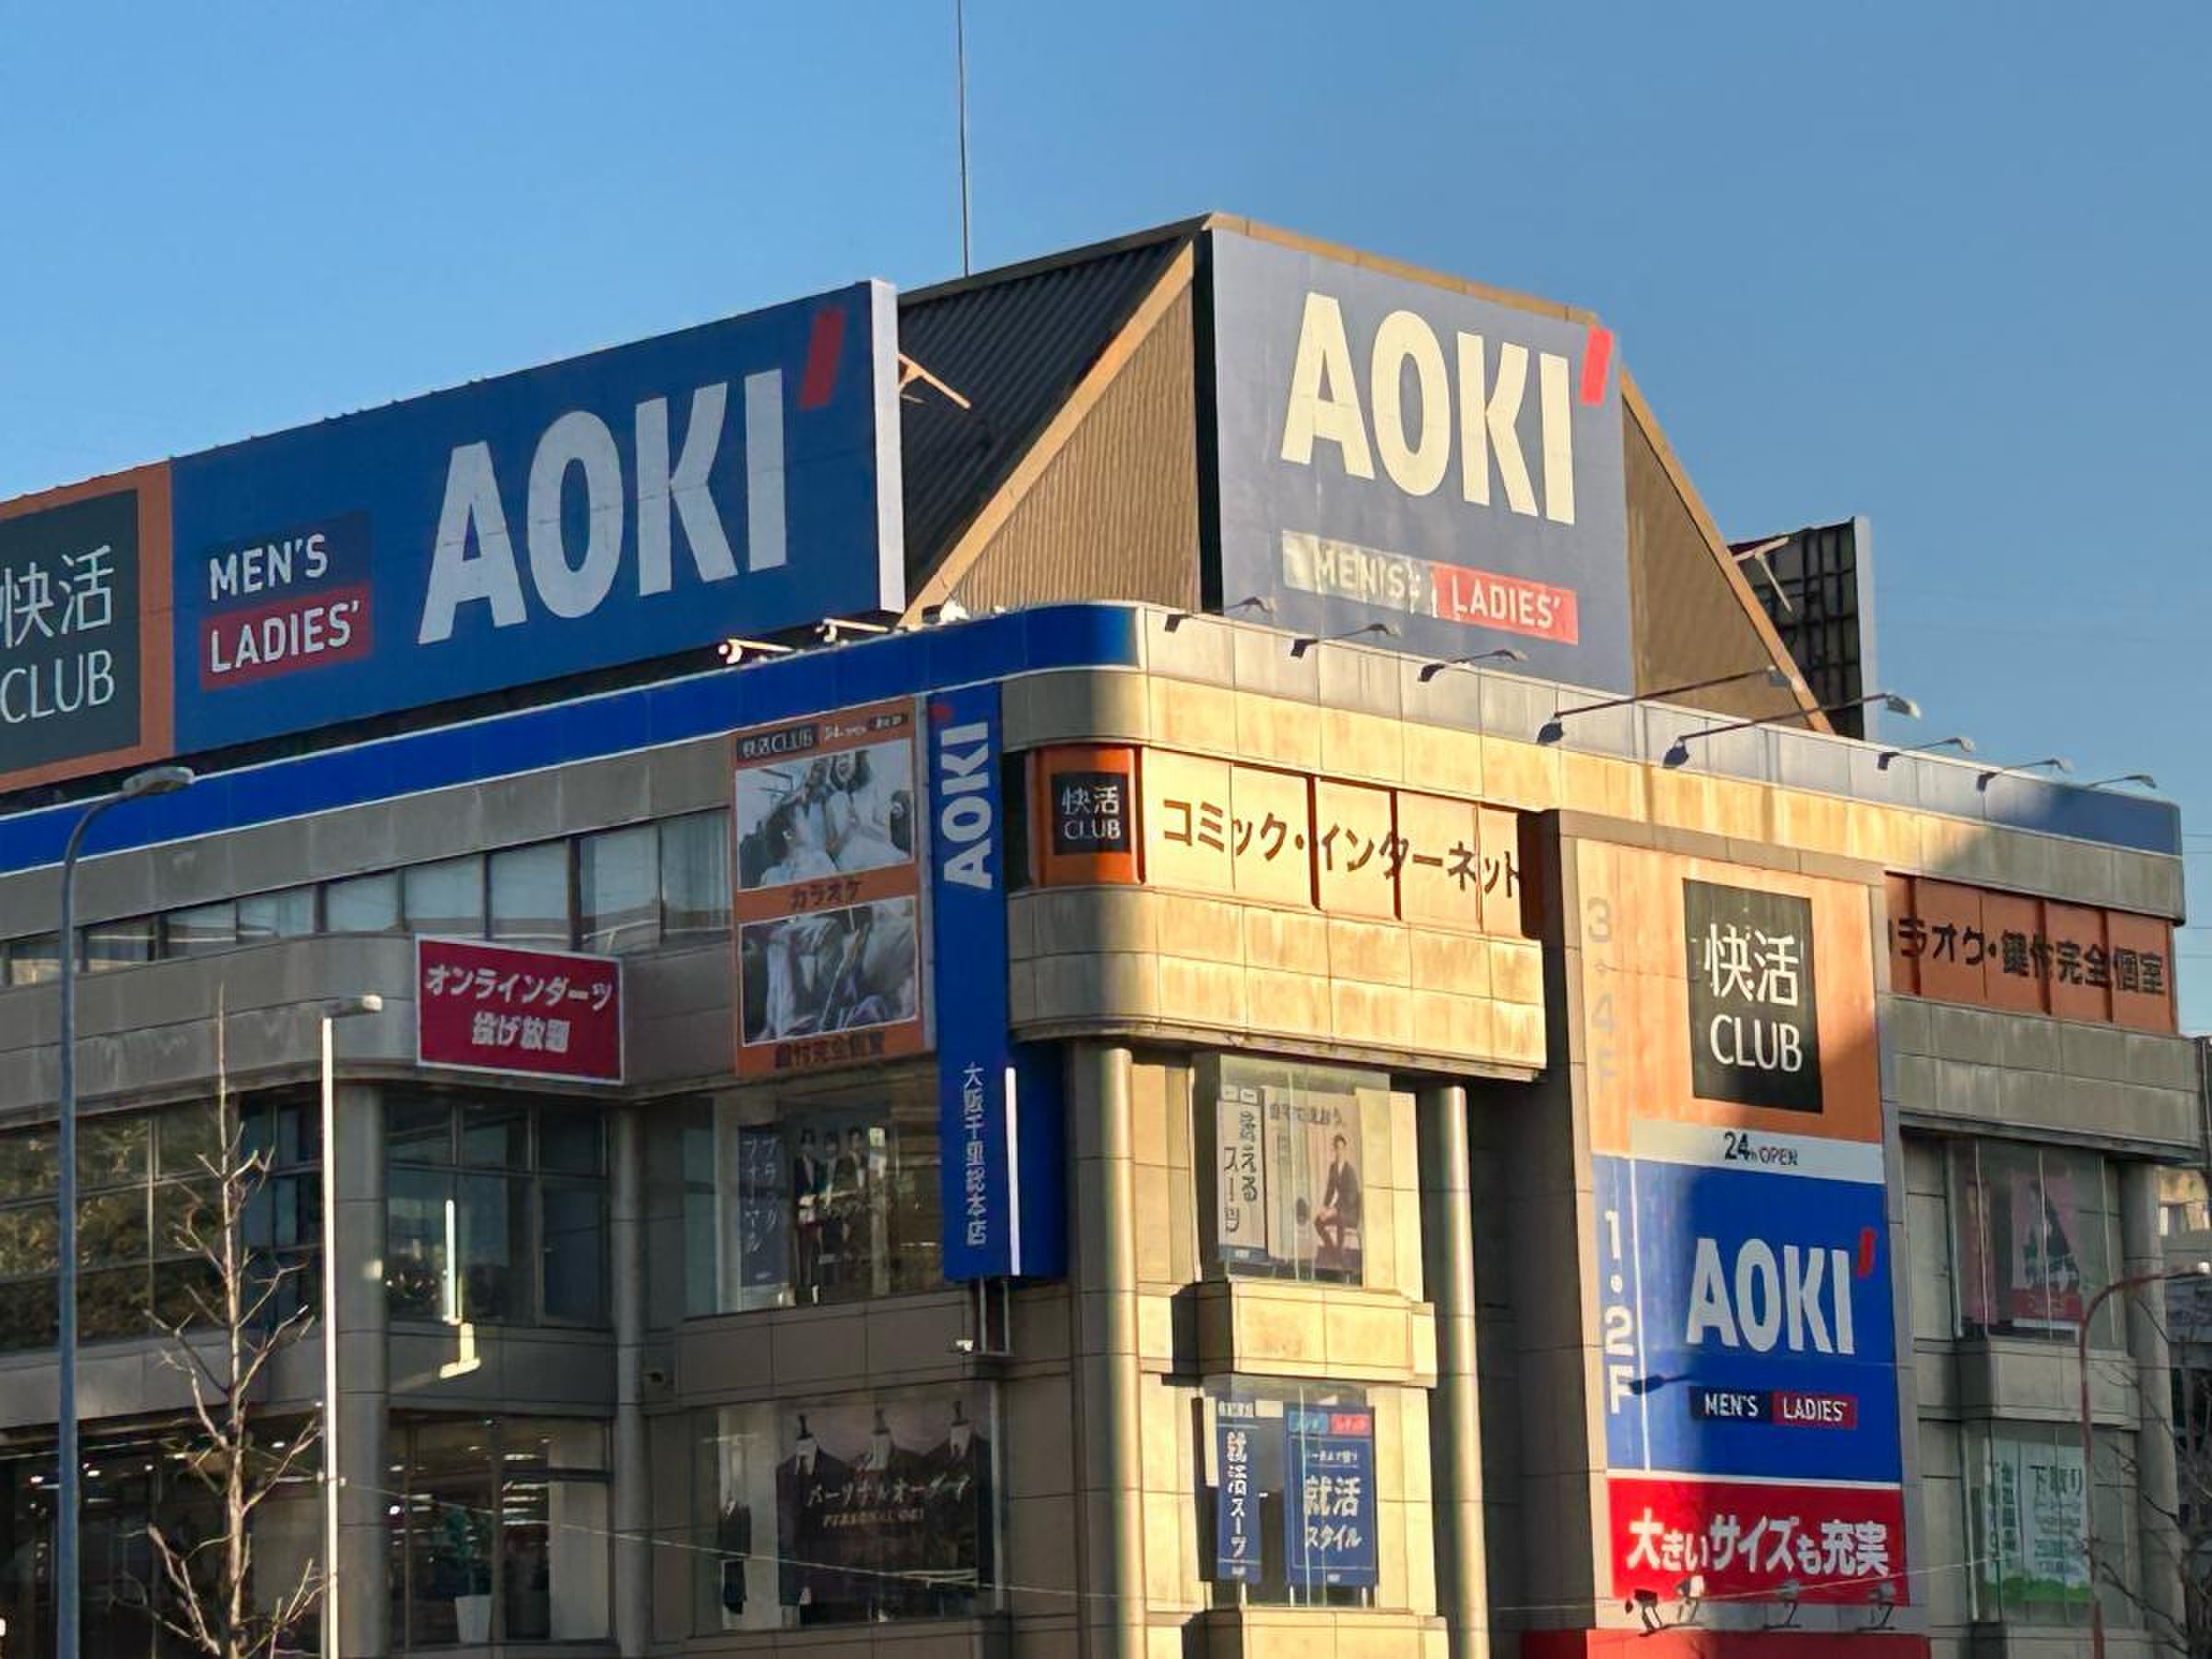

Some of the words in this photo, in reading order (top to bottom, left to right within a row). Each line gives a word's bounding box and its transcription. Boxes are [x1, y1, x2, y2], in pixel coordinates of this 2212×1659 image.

[0, 544, 114, 647] 快活
[208, 532, 329, 602] MEN'S
[1453, 574, 1560, 629] LADIES'
[209, 599, 361, 674] LADIES'
[1, 649, 115, 724] CLUB
[1061, 784, 1121, 816] 快活
[1063, 818, 1122, 841] CLUB
[425, 964, 613, 1011] オンラインダーツ
[1704, 923, 1800, 1006] 快活
[1710, 1014, 1803, 1073] CLUB
[1704, 1393, 1759, 1418] MEN'S
[1303, 1475, 1361, 1517] 就活
[1306, 1524, 1362, 1552] スタイル
[1626, 1506, 1889, 1578] 大きいサイズも充実
